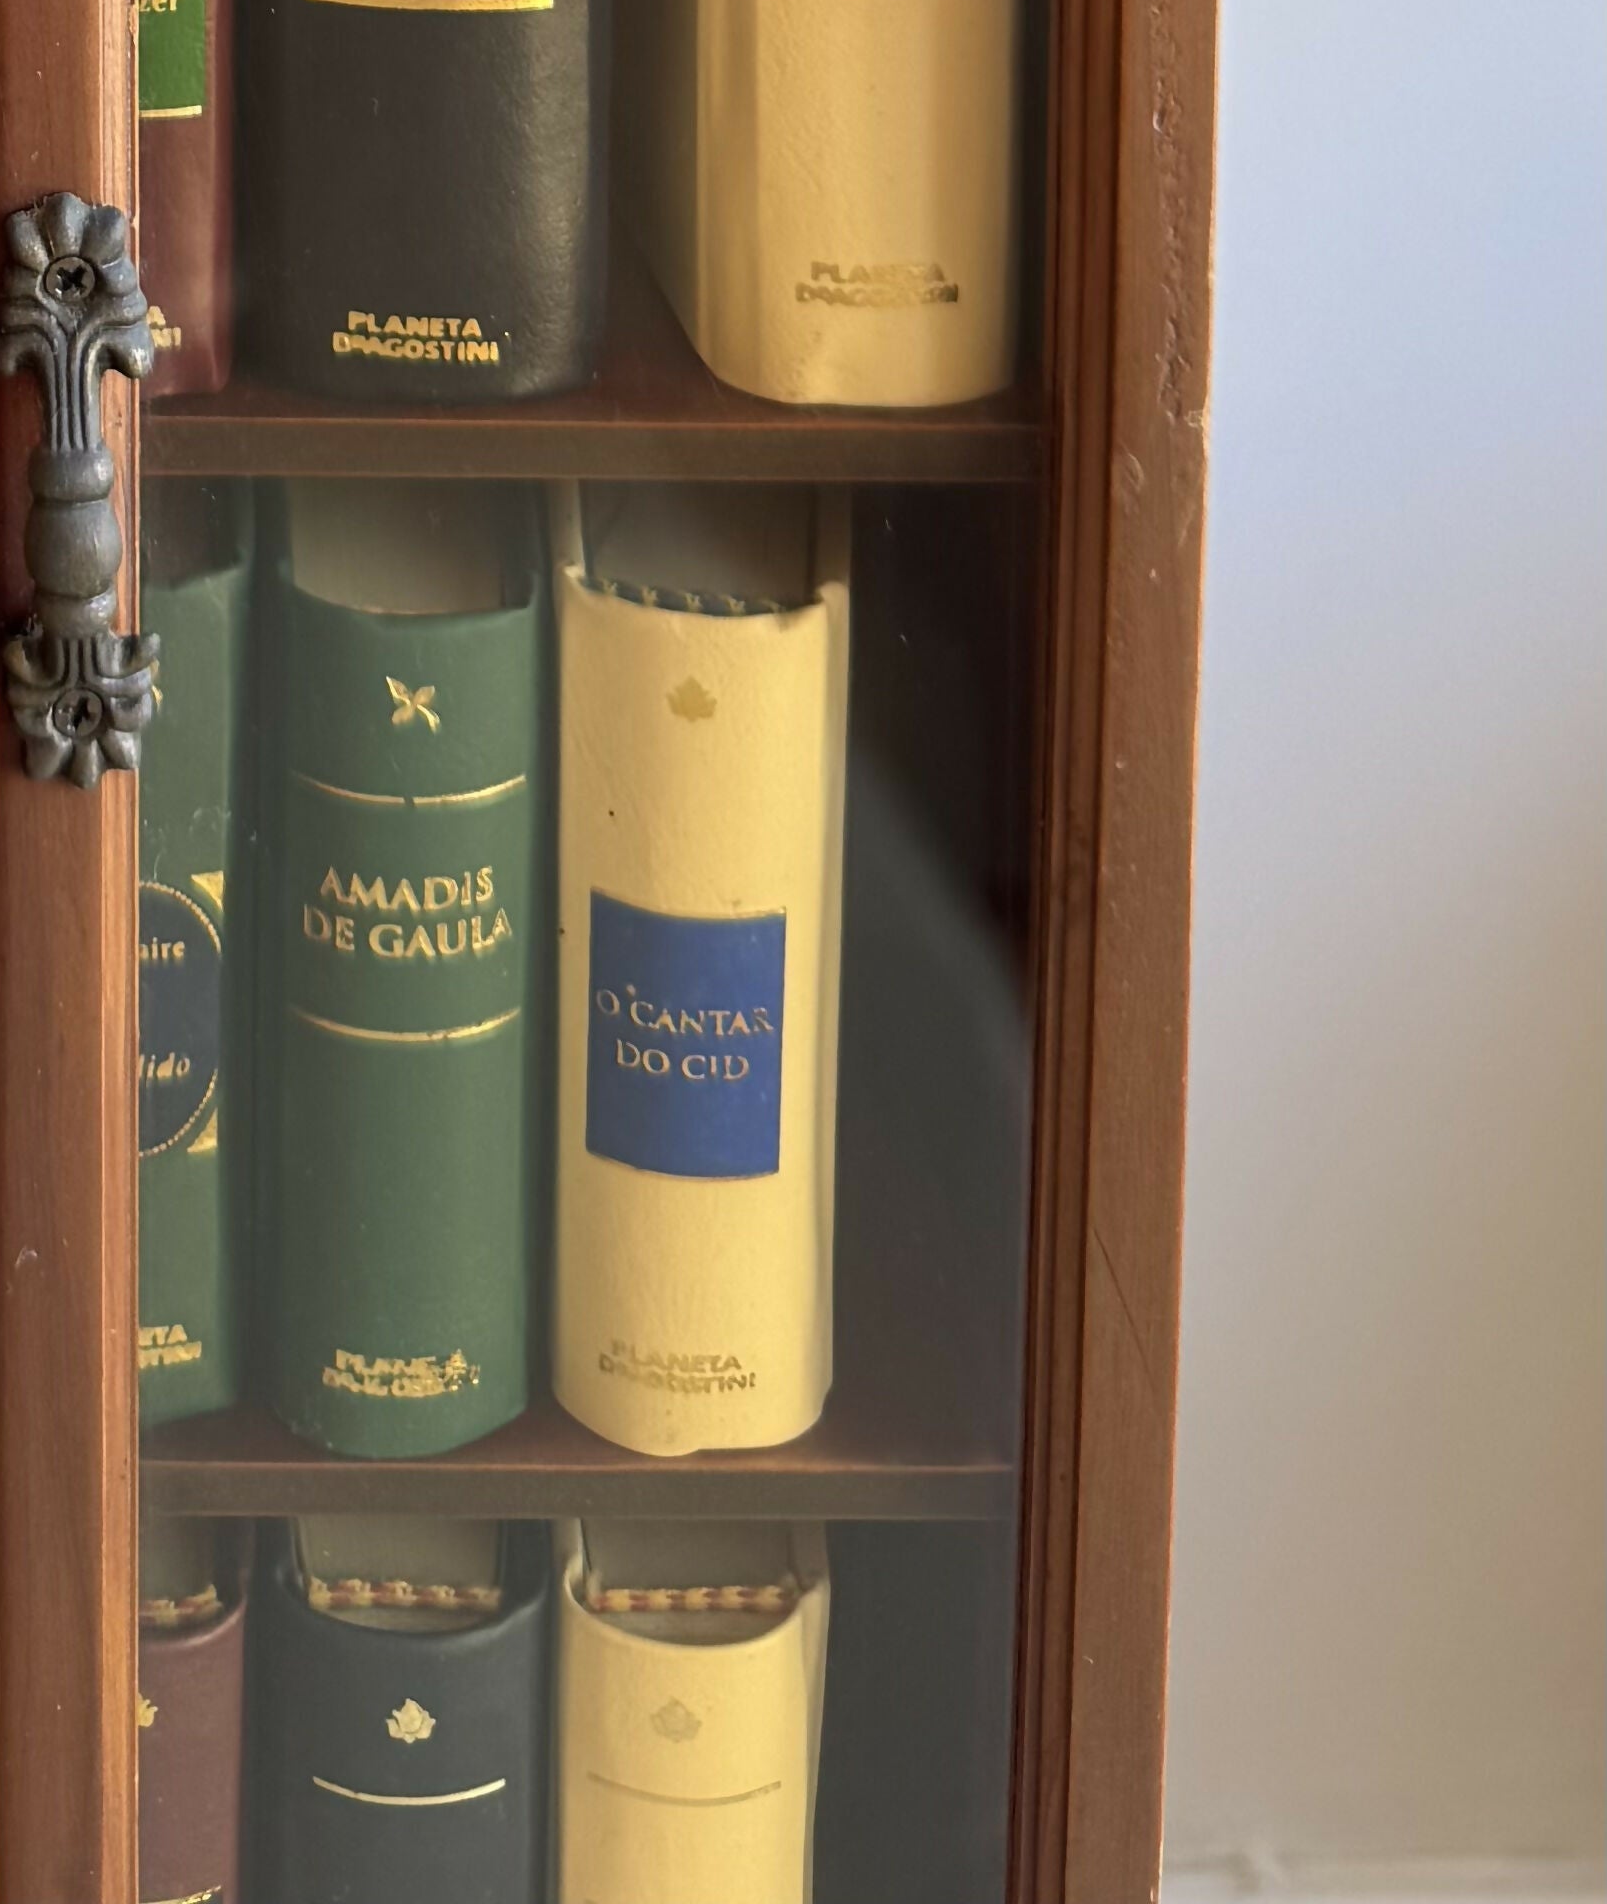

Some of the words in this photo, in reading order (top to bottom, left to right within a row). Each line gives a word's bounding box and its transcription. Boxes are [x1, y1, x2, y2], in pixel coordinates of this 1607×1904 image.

[346, 309, 484, 340] PLANETA
[319, 864, 495, 913] AMADIS
[303, 903, 356, 952] DE
[367, 906, 514, 961] GAULA
[596, 988, 621, 1017] O
[629, 999, 775, 1037] CANTAR
[615, 1038, 672, 1075] DO
[680, 1053, 751, 1081] CID
